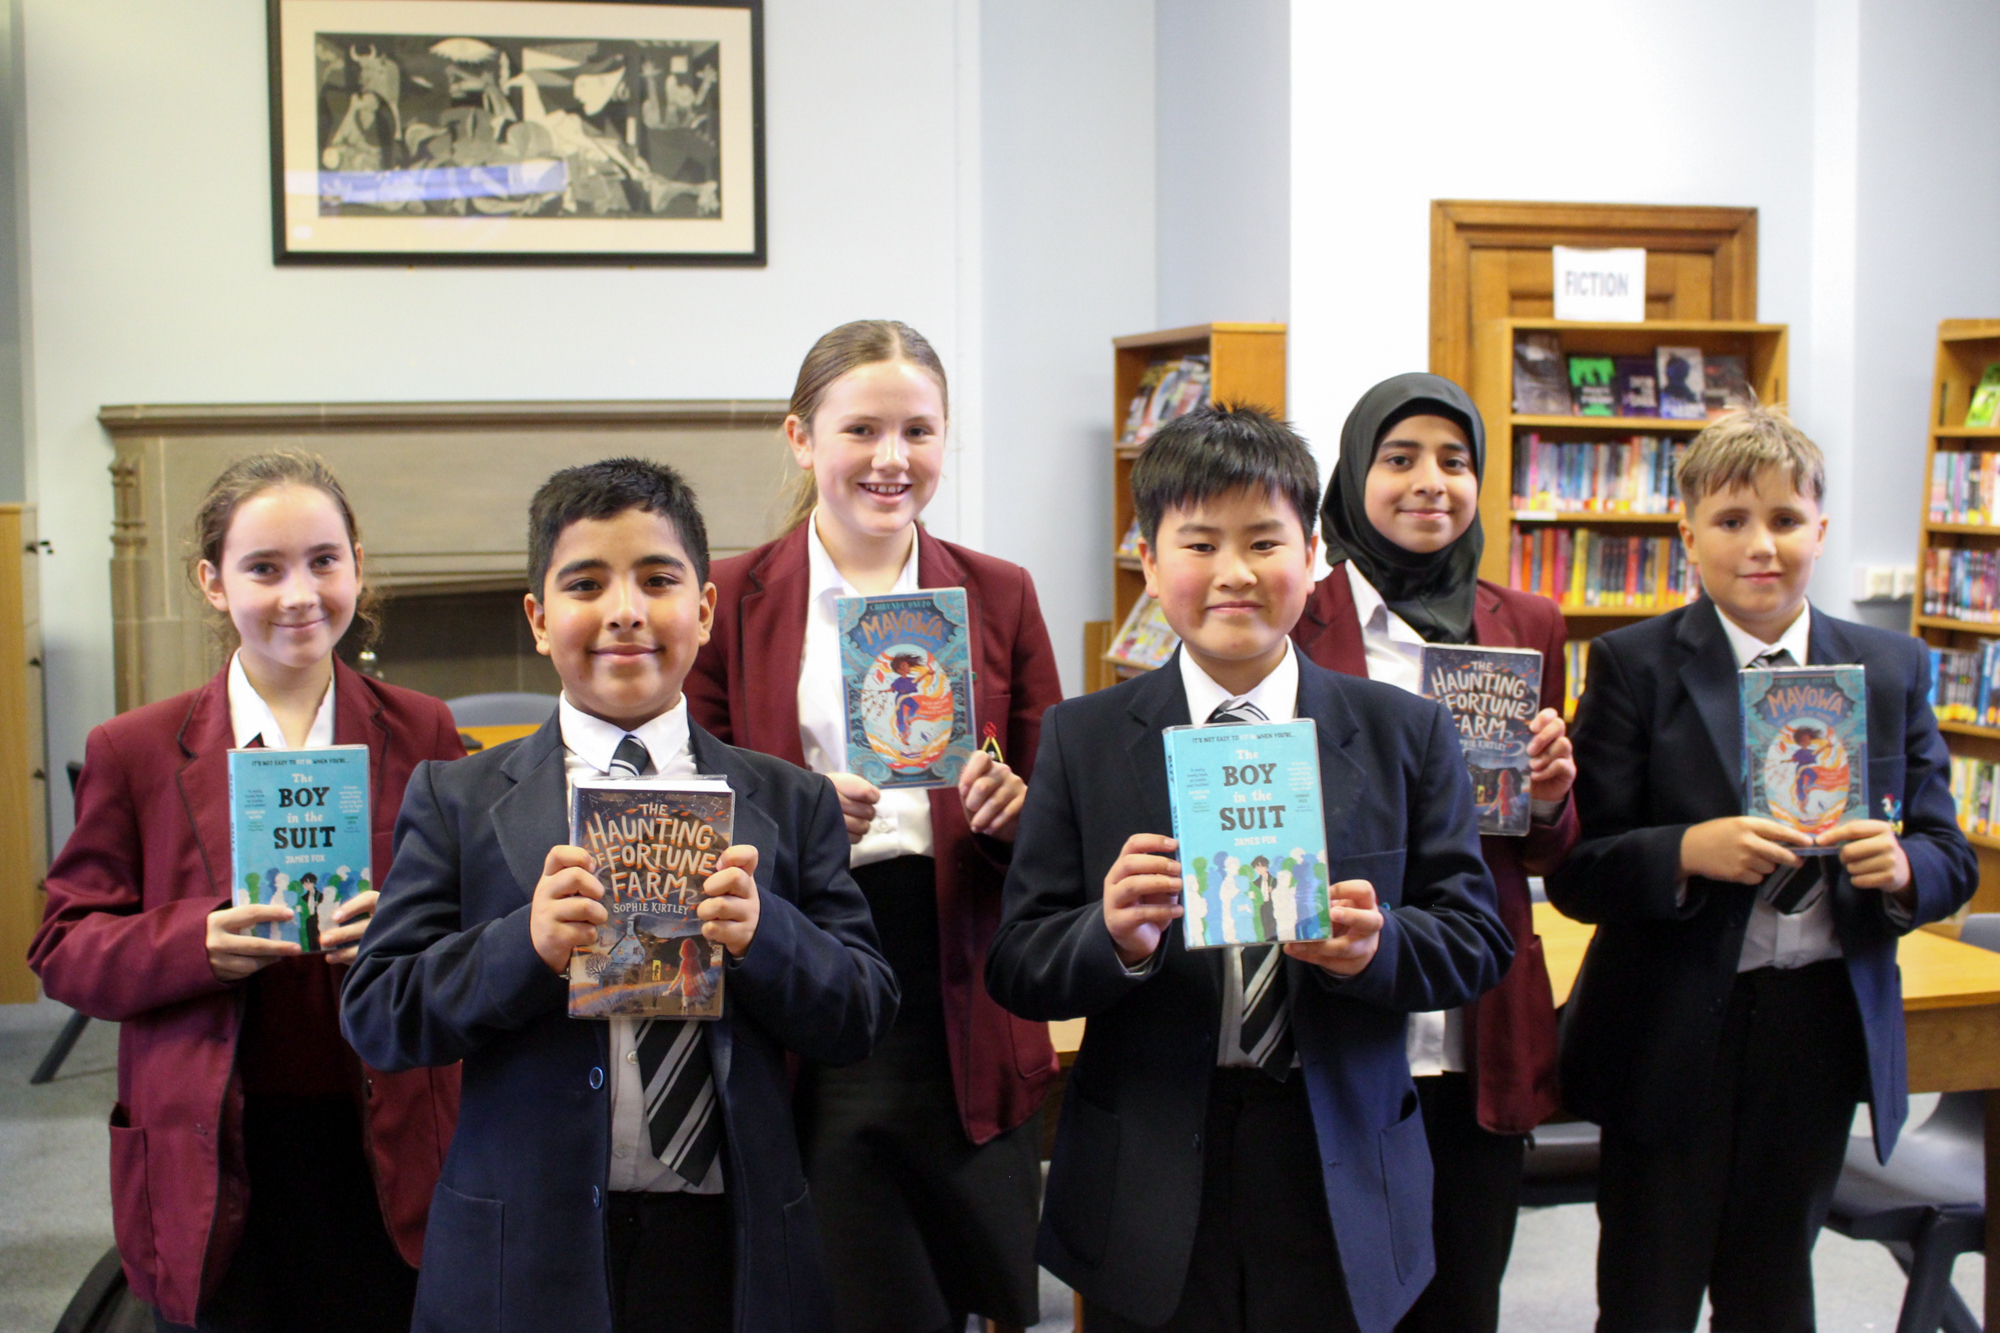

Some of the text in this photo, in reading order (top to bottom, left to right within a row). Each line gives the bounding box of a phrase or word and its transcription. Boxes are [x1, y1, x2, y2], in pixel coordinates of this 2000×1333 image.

[1565, 270, 1629, 297] FICTION
[861, 609, 943, 645] MAYOWA
[1471, 660, 1493, 672] THE
[1430, 666, 1527, 699] HAUNTING
[1445, 692, 1528, 720] FORTUNE
[1767, 685, 1843, 718] MAYOWA
[1235, 749, 1260, 760] The
[292, 773, 314, 783] The
[1222, 763, 1277, 787] BOY
[278, 787, 330, 808] BOY
[1233, 789, 1273, 803] in the
[286, 811, 324, 824] in the
[639, 802, 668, 816] THE
[1219, 805, 1286, 831] SUIT
[273, 826, 336, 849] SUIT
[586, 810, 714, 852] HAUNTING
[1234, 835, 1278, 847] JAMES FOX
[285, 853, 326, 864] JAMES FOX
[606, 843, 717, 877] FORTUNE
[611, 872, 688, 905] FARM
[613, 902, 690, 915] SOPHIE KIRTLEY
